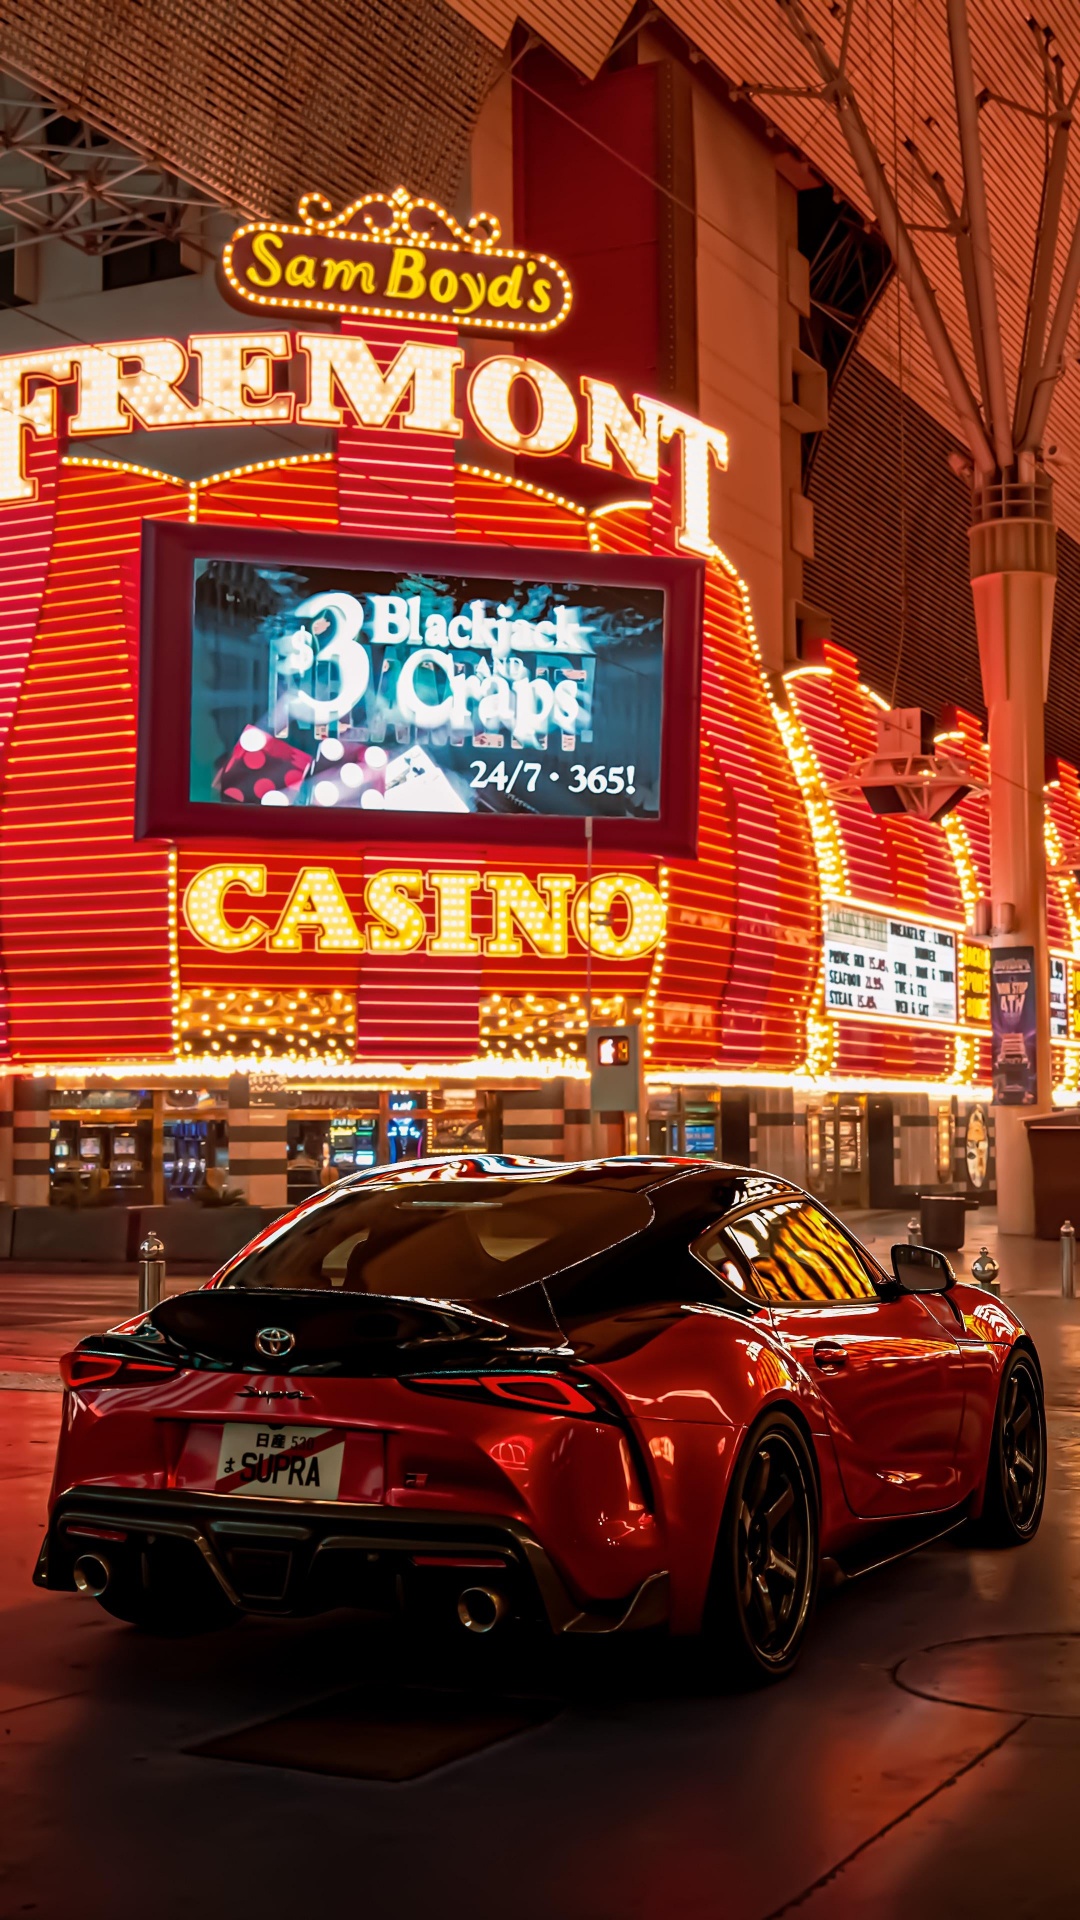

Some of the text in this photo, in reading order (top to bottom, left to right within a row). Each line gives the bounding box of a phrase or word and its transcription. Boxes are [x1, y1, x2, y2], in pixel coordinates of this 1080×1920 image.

[246, 233, 551, 314] Sam Boyd's
[0, 331, 728, 556] FREMONT
[371, 595, 594, 657] Blackjack
[396, 648, 579, 748] Craps
[474, 656, 530, 681] AND
[469, 759, 636, 795] 24/7 365!
[183, 863, 667, 960] CASINO
[234, 1385, 315, 1405] Supra
[240, 1452, 320, 1487] SUPRA
